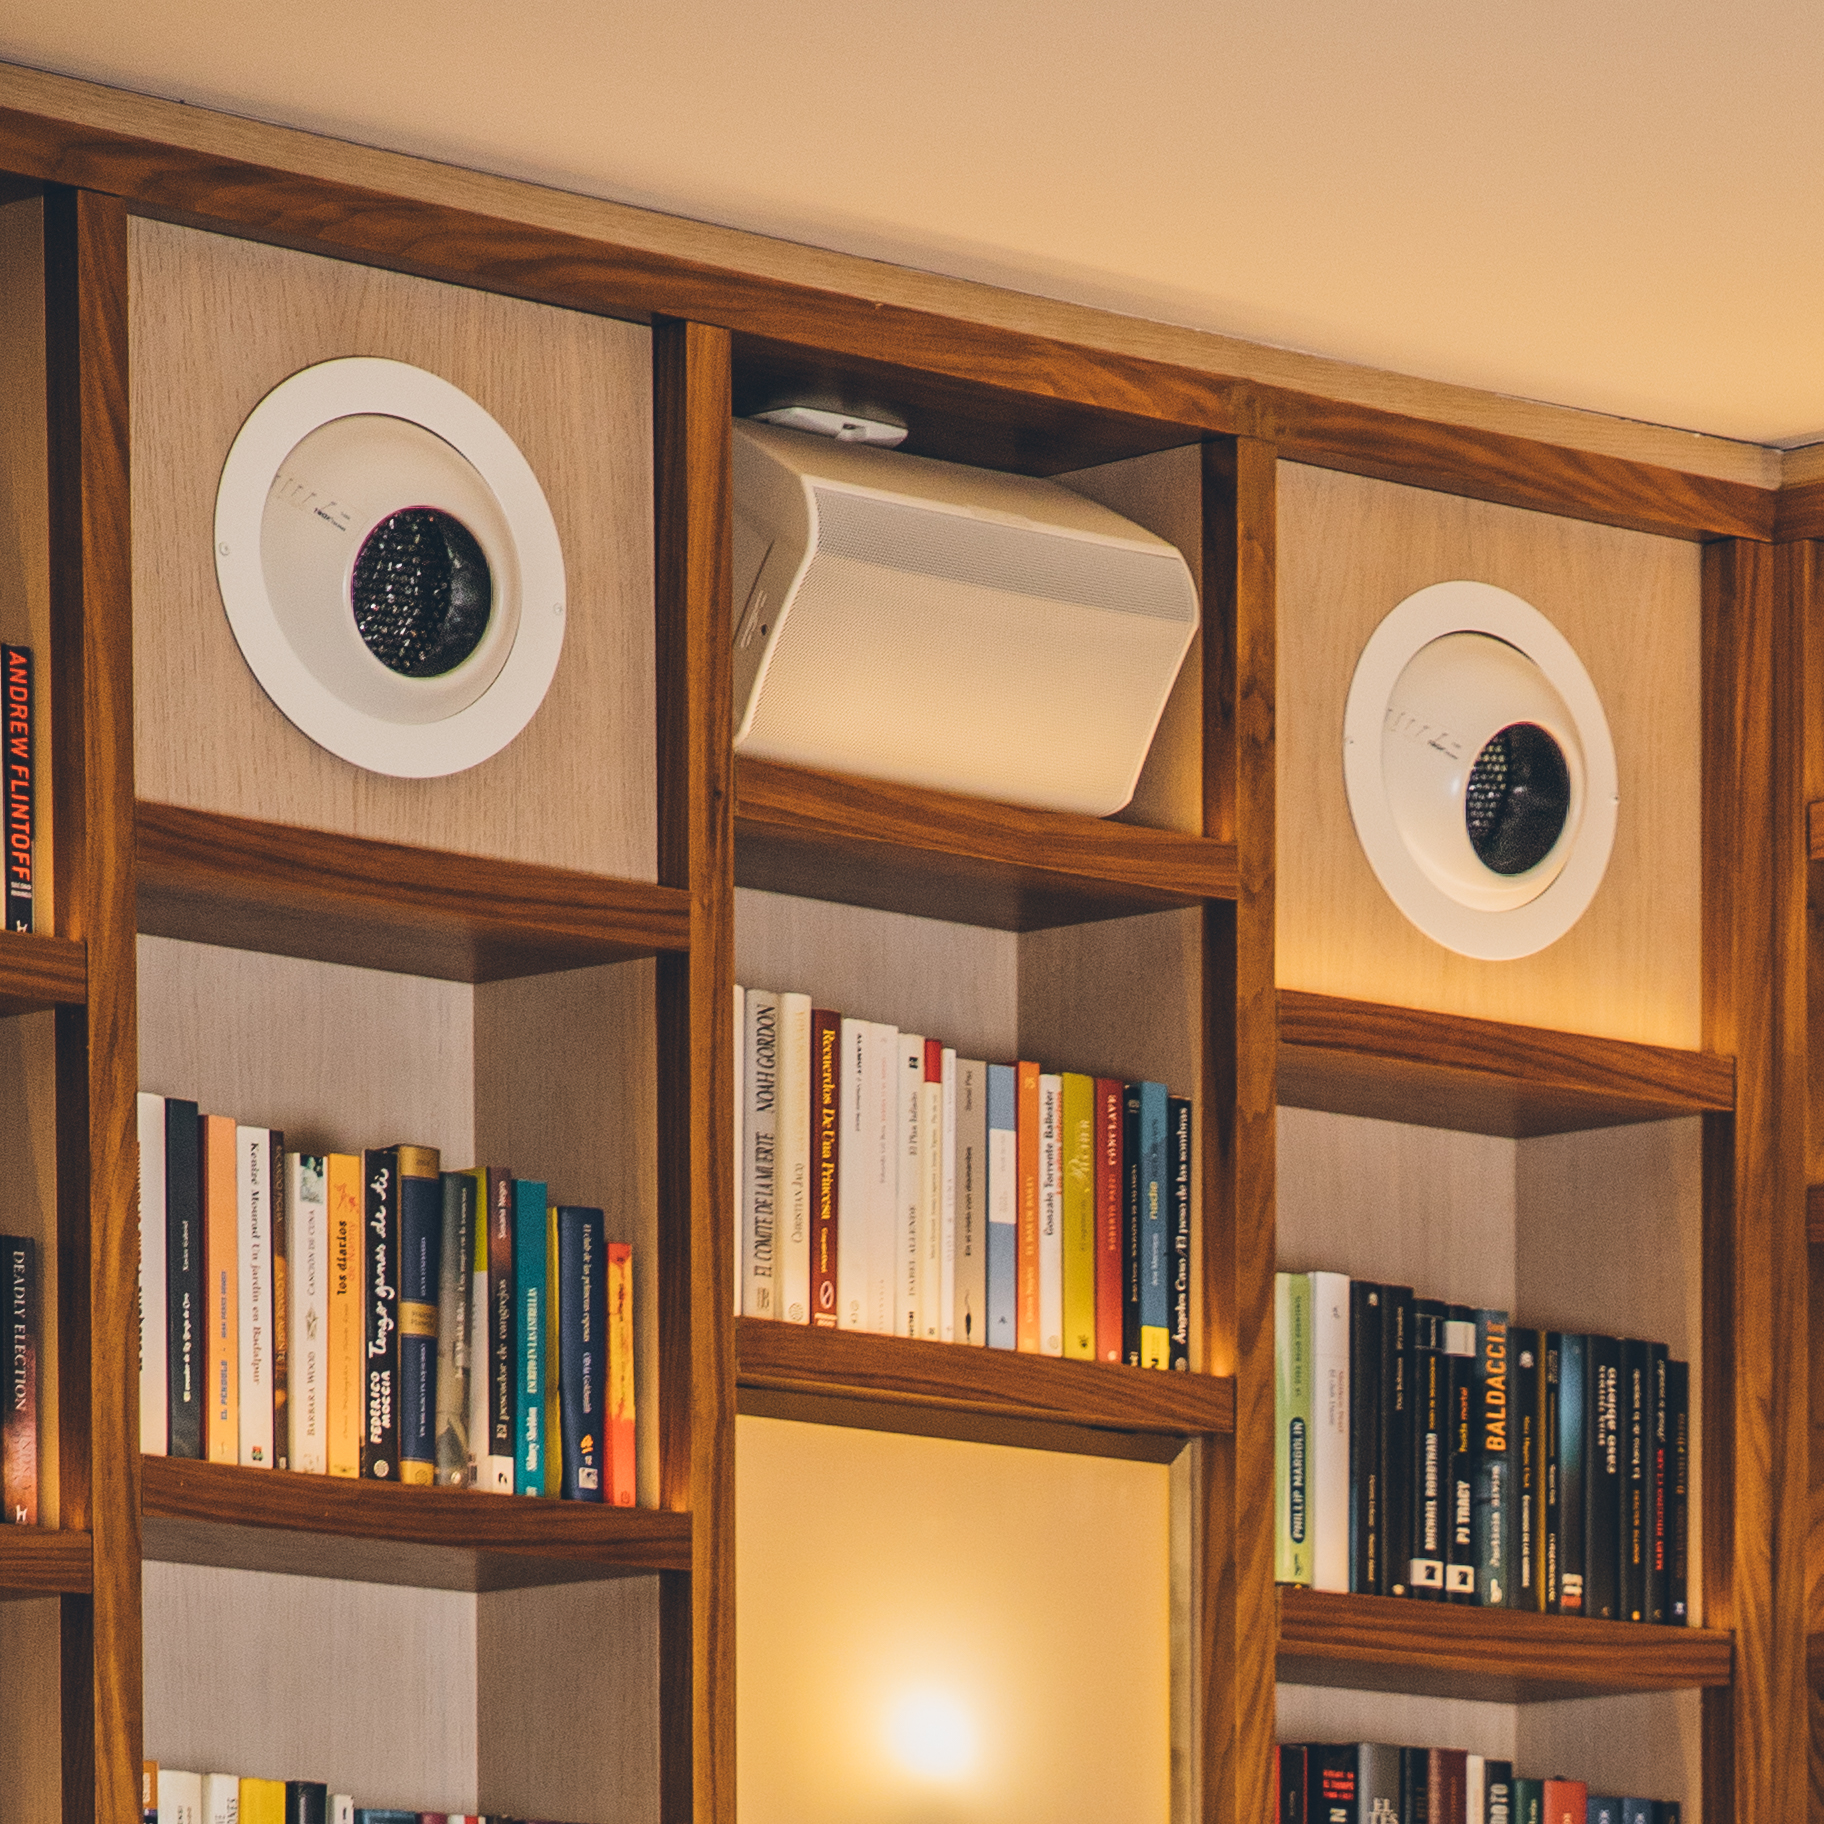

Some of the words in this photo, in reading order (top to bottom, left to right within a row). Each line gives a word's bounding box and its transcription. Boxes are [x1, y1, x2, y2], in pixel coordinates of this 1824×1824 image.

[9, 650, 28, 758] ANDREW
[11, 764, 30, 881] FLINTOFF
[756, 1004, 776, 1069] GORDON
[756, 1072, 776, 1112] NOAH
[821, 1029, 835, 1104] Recuerdos
[821, 1109, 835, 1127] De
[821, 1131, 835, 1158] Una
[250, 1189, 261, 1238] Mourad
[821, 1162, 835, 1219] Princesa
[1175, 1185, 1187, 1201] de
[337, 1220, 347, 1271] diarios
[370, 1206, 386, 1239] de
[251, 1244, 261, 1260] Un
[374, 1244, 395, 1300] ganas
[13, 1250, 26, 1318] DEADLY
[337, 1275, 347, 1295] los
[253, 1306, 260, 1321] en
[368, 1301, 394, 1359] Tengo
[1171, 1293, 1188, 1344] Ángeles
[13, 1324, 26, 1411] ELECTION
[250, 1326, 262, 1384] Badalpur
[306, 1351, 315, 1384] WOOD
[497, 1343, 507, 1360] de
[306, 1387, 315, 1436] BARBARA
[369, 1371, 383, 1444] FEDERICO
[380, 1370, 391, 1428] MOCCIA
[496, 1424, 506, 1438] El
[1293, 1421, 1303, 1487] MARGOLIN
[1293, 1490, 1303, 1539] PHILLIP
